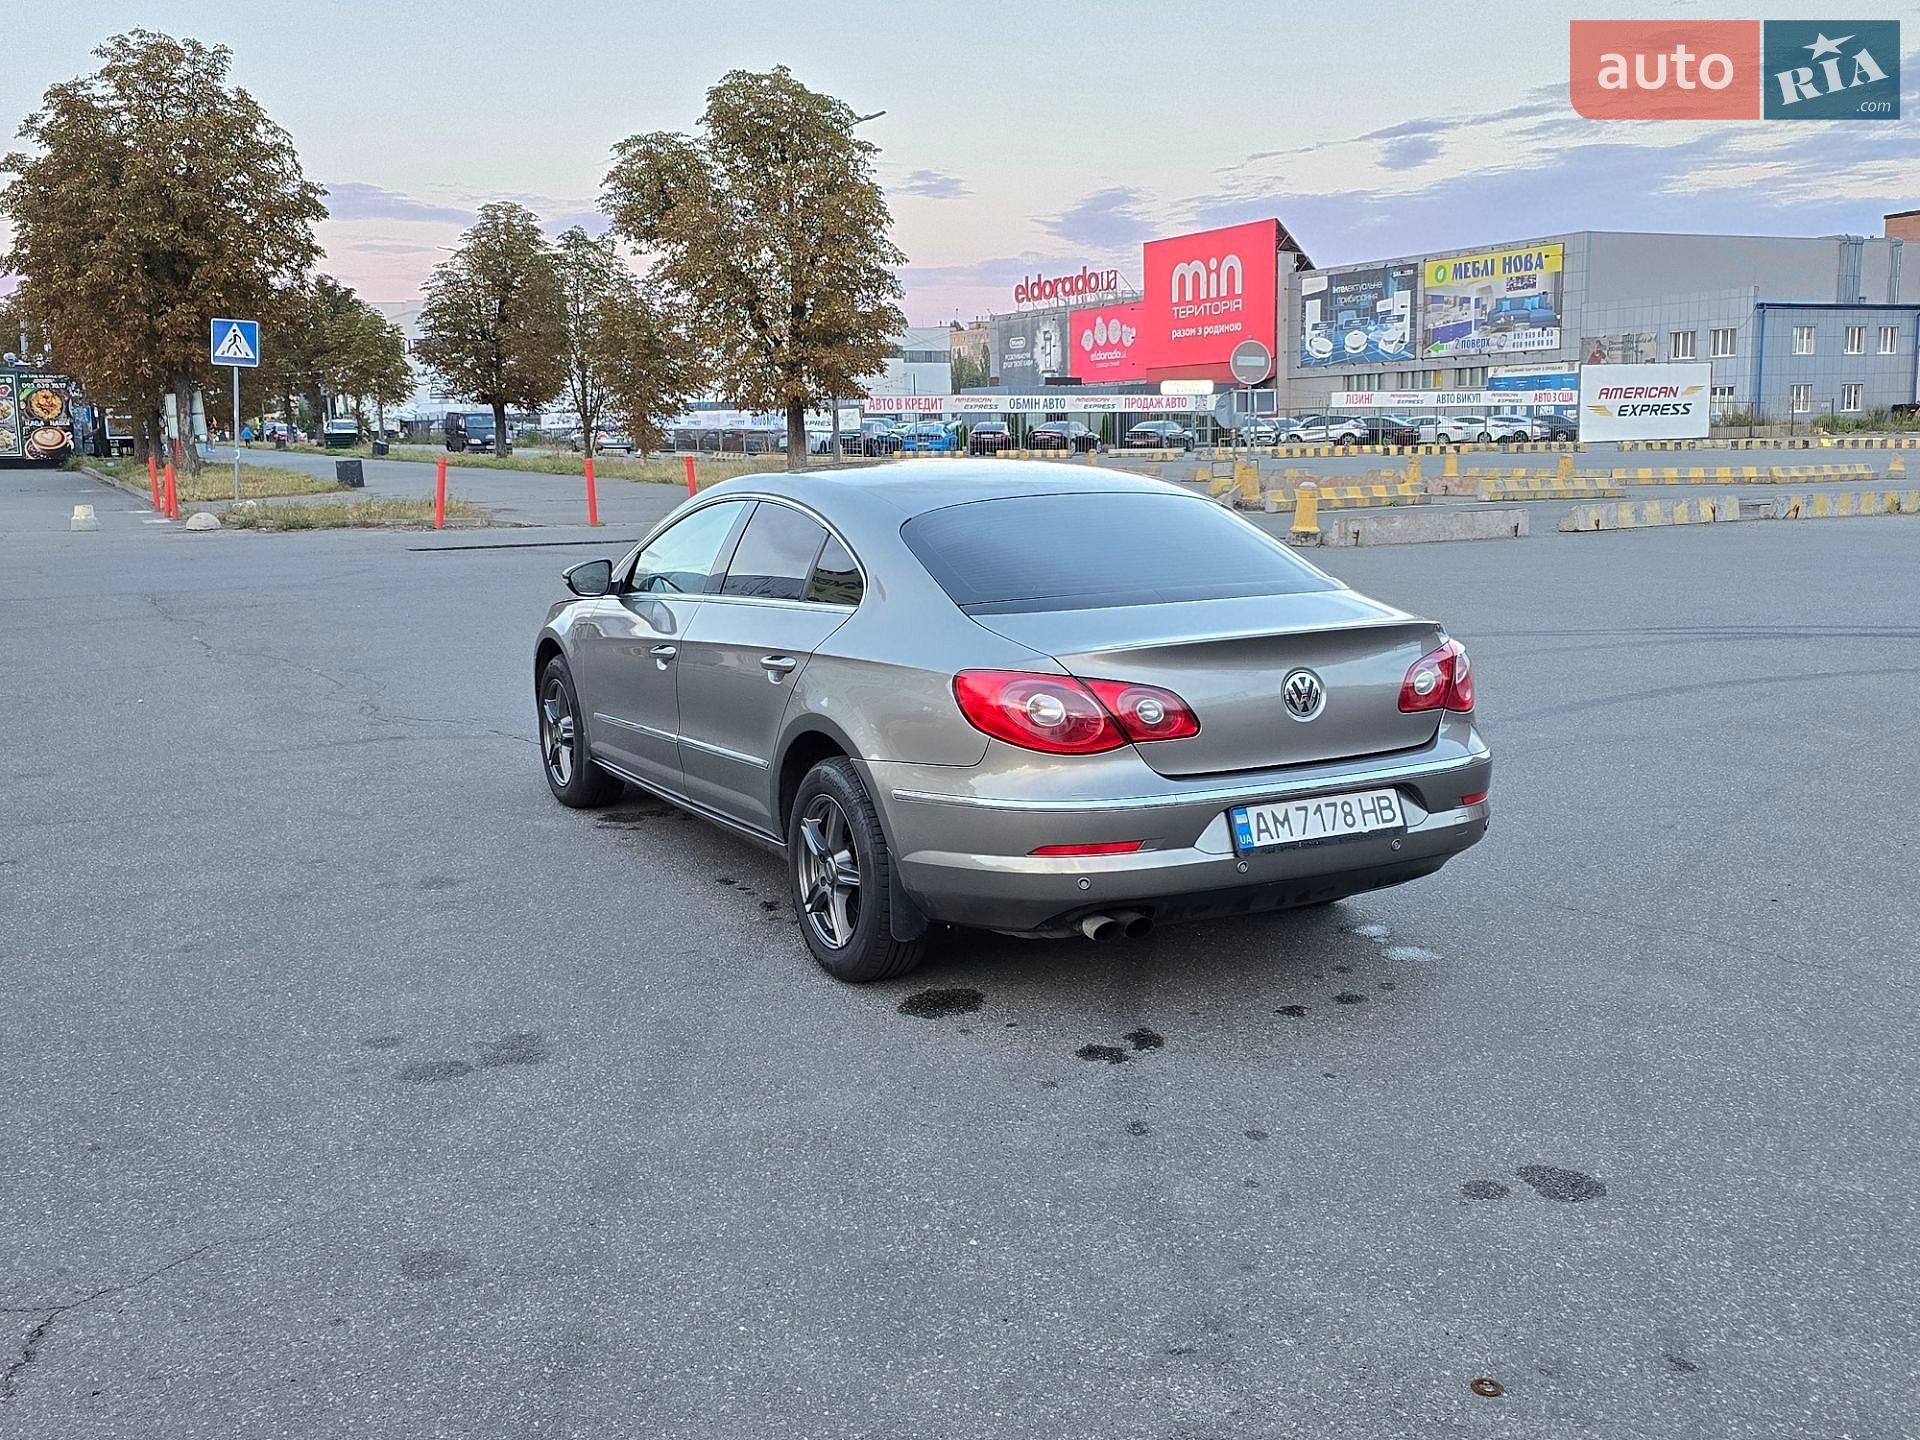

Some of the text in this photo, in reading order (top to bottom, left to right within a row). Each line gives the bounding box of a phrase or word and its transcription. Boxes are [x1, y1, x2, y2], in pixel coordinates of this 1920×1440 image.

[1452, 252, 1544, 281] МЕБЛІ НОВА
[1014, 265, 1117, 303] eldorado.ua
[1171, 298, 1243, 320] ТЕРИТОРІЯ
[1171, 321, 1242, 340] разом з родиною
[1454, 338, 1490, 350] 2 поверх
[1345, 393, 1374, 404] ЛІЗИНГ
[1436, 393, 1481, 404] АВТО ВИКУП
[1533, 392, 1551, 403] АВТО
[1557, 392, 1573, 402] США
[1598, 386, 1679, 399] AMERICAN
[869, 398, 944, 412] АВТО В КРЕДИТ
[1009, 398, 1066, 409] ОБМІН АВТО
[1124, 397, 1188, 410] ПРОДАЖ АВТО
[1618, 402, 1692, 416] EXPRESS
[1239, 833, 1252, 845] UA
